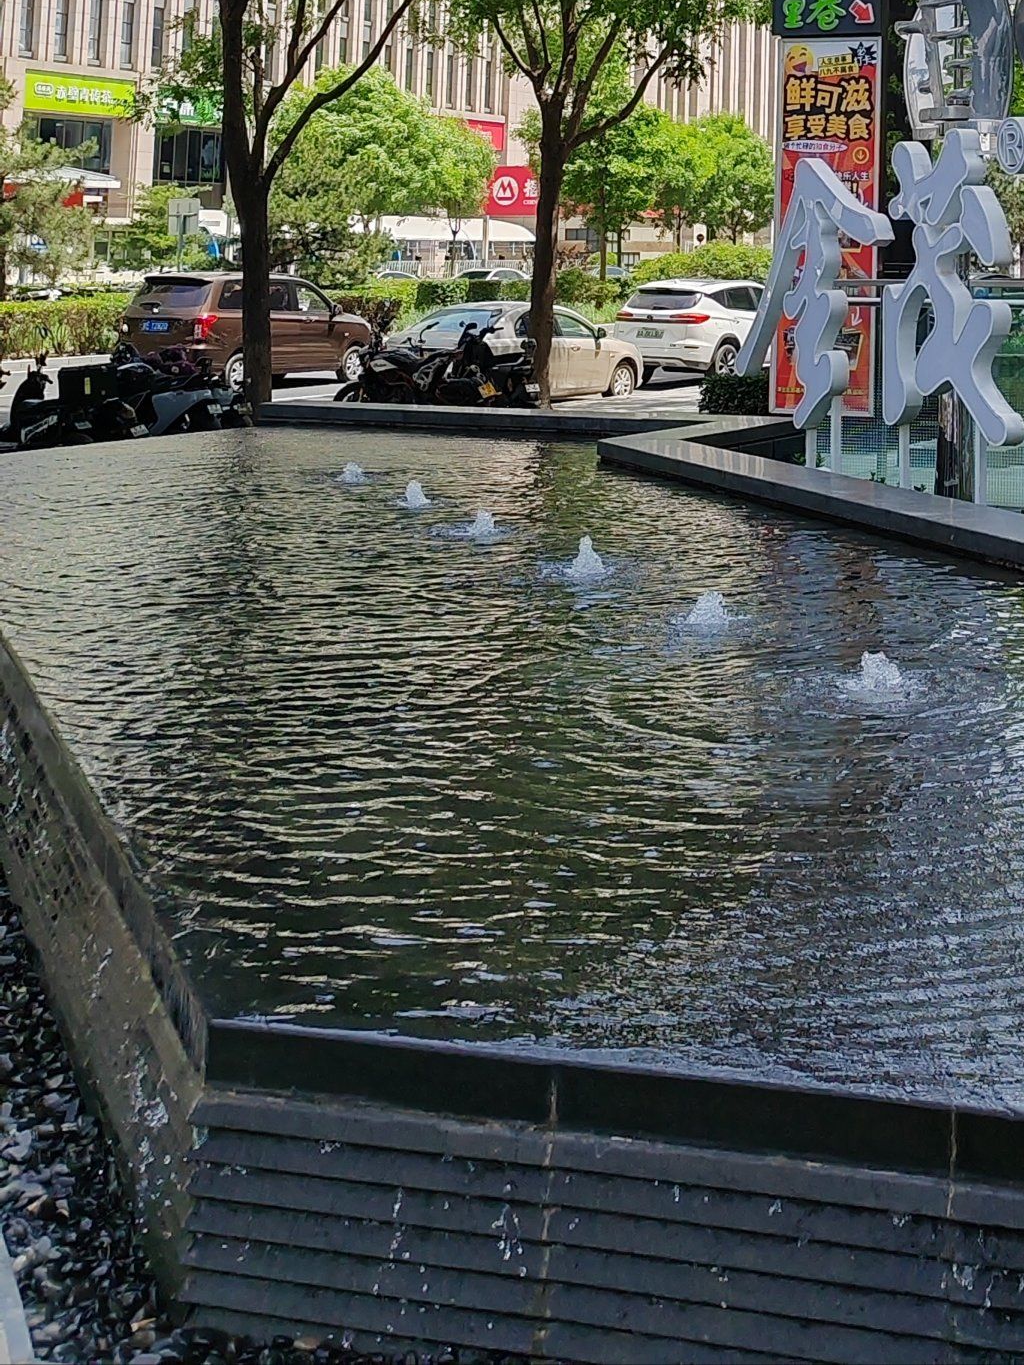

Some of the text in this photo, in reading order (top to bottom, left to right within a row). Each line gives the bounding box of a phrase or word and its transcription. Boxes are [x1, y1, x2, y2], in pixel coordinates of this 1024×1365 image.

[786, 77, 871, 114] 鲜可滋
[785, 114, 870, 140] 享受美食
